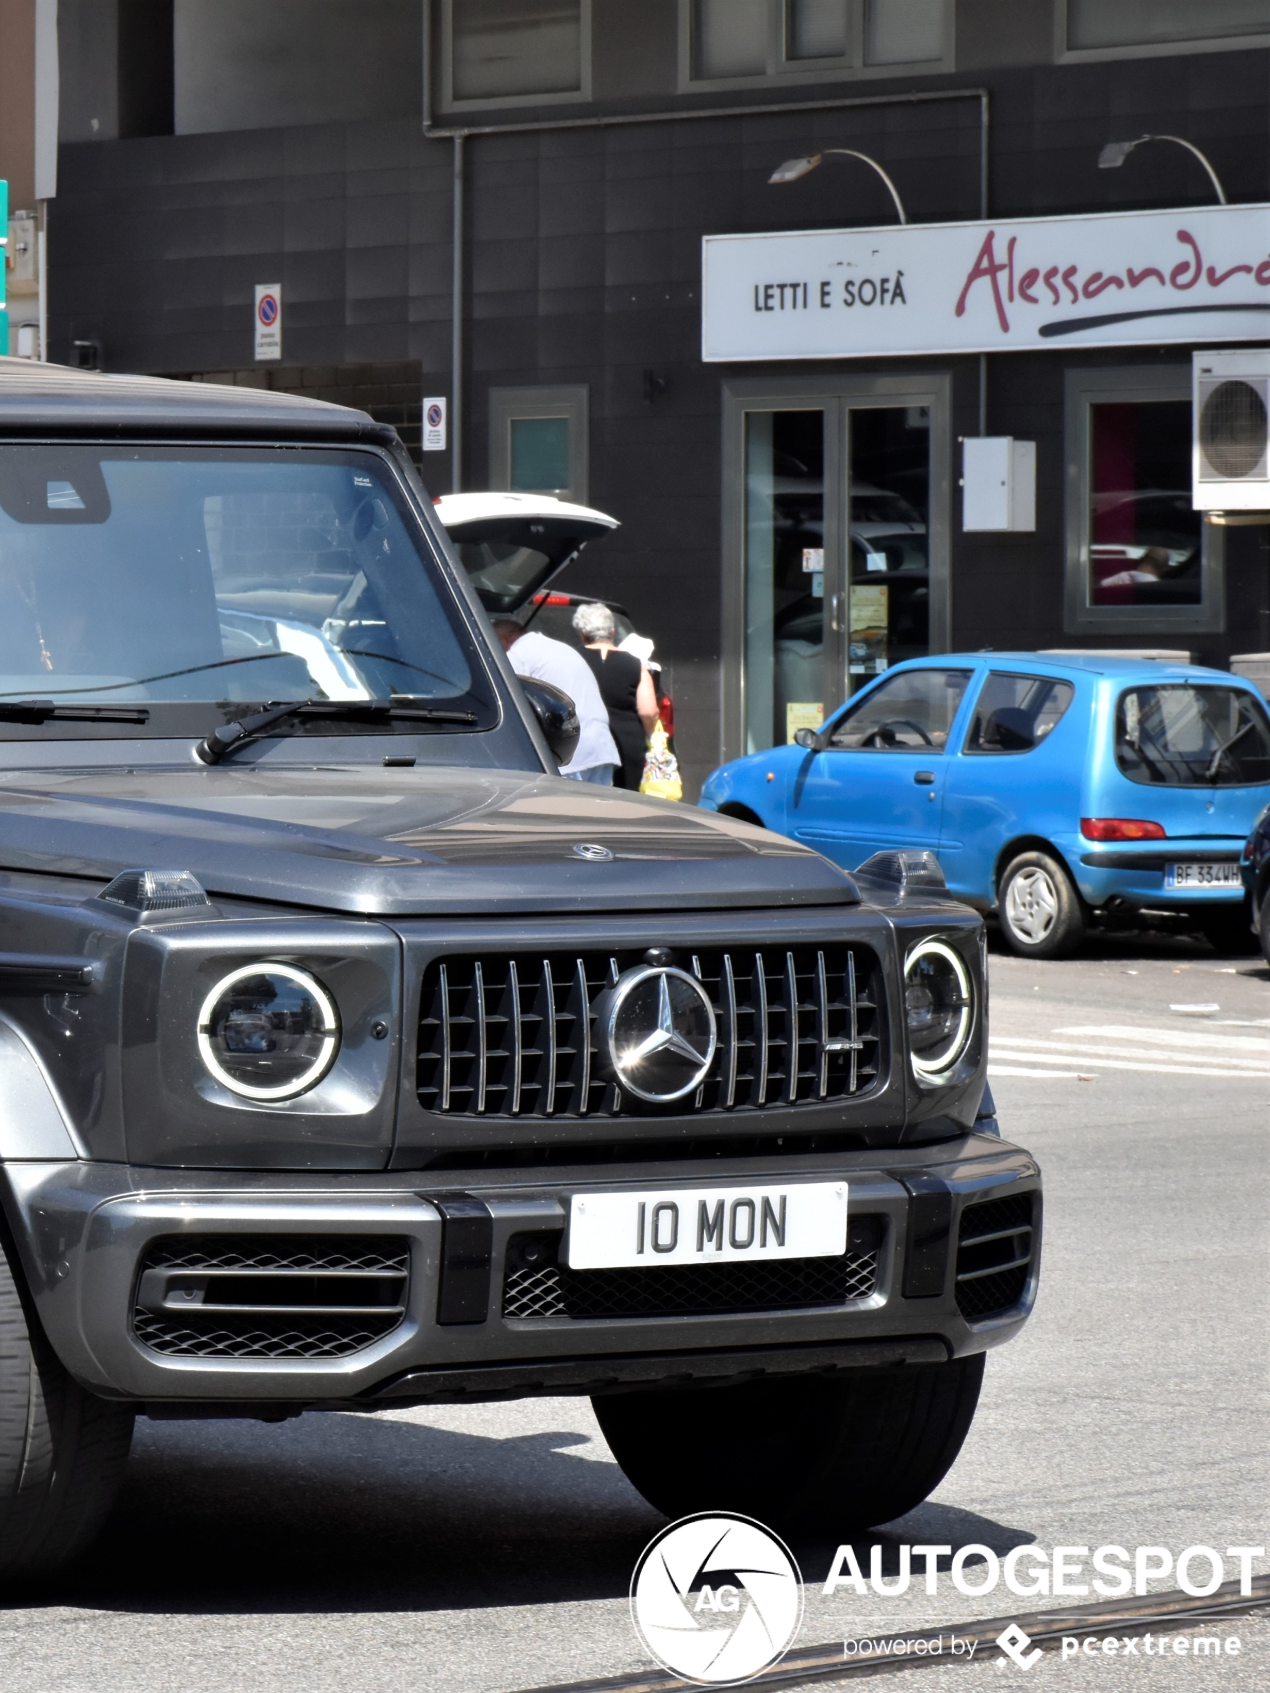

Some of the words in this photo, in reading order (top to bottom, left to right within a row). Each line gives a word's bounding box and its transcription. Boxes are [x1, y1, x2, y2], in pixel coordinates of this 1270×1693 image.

[753, 282, 808, 313] LETTI
[820, 279, 832, 309] E
[1176, 865, 1192, 883] BF
[696, 1194, 787, 1250] MON
